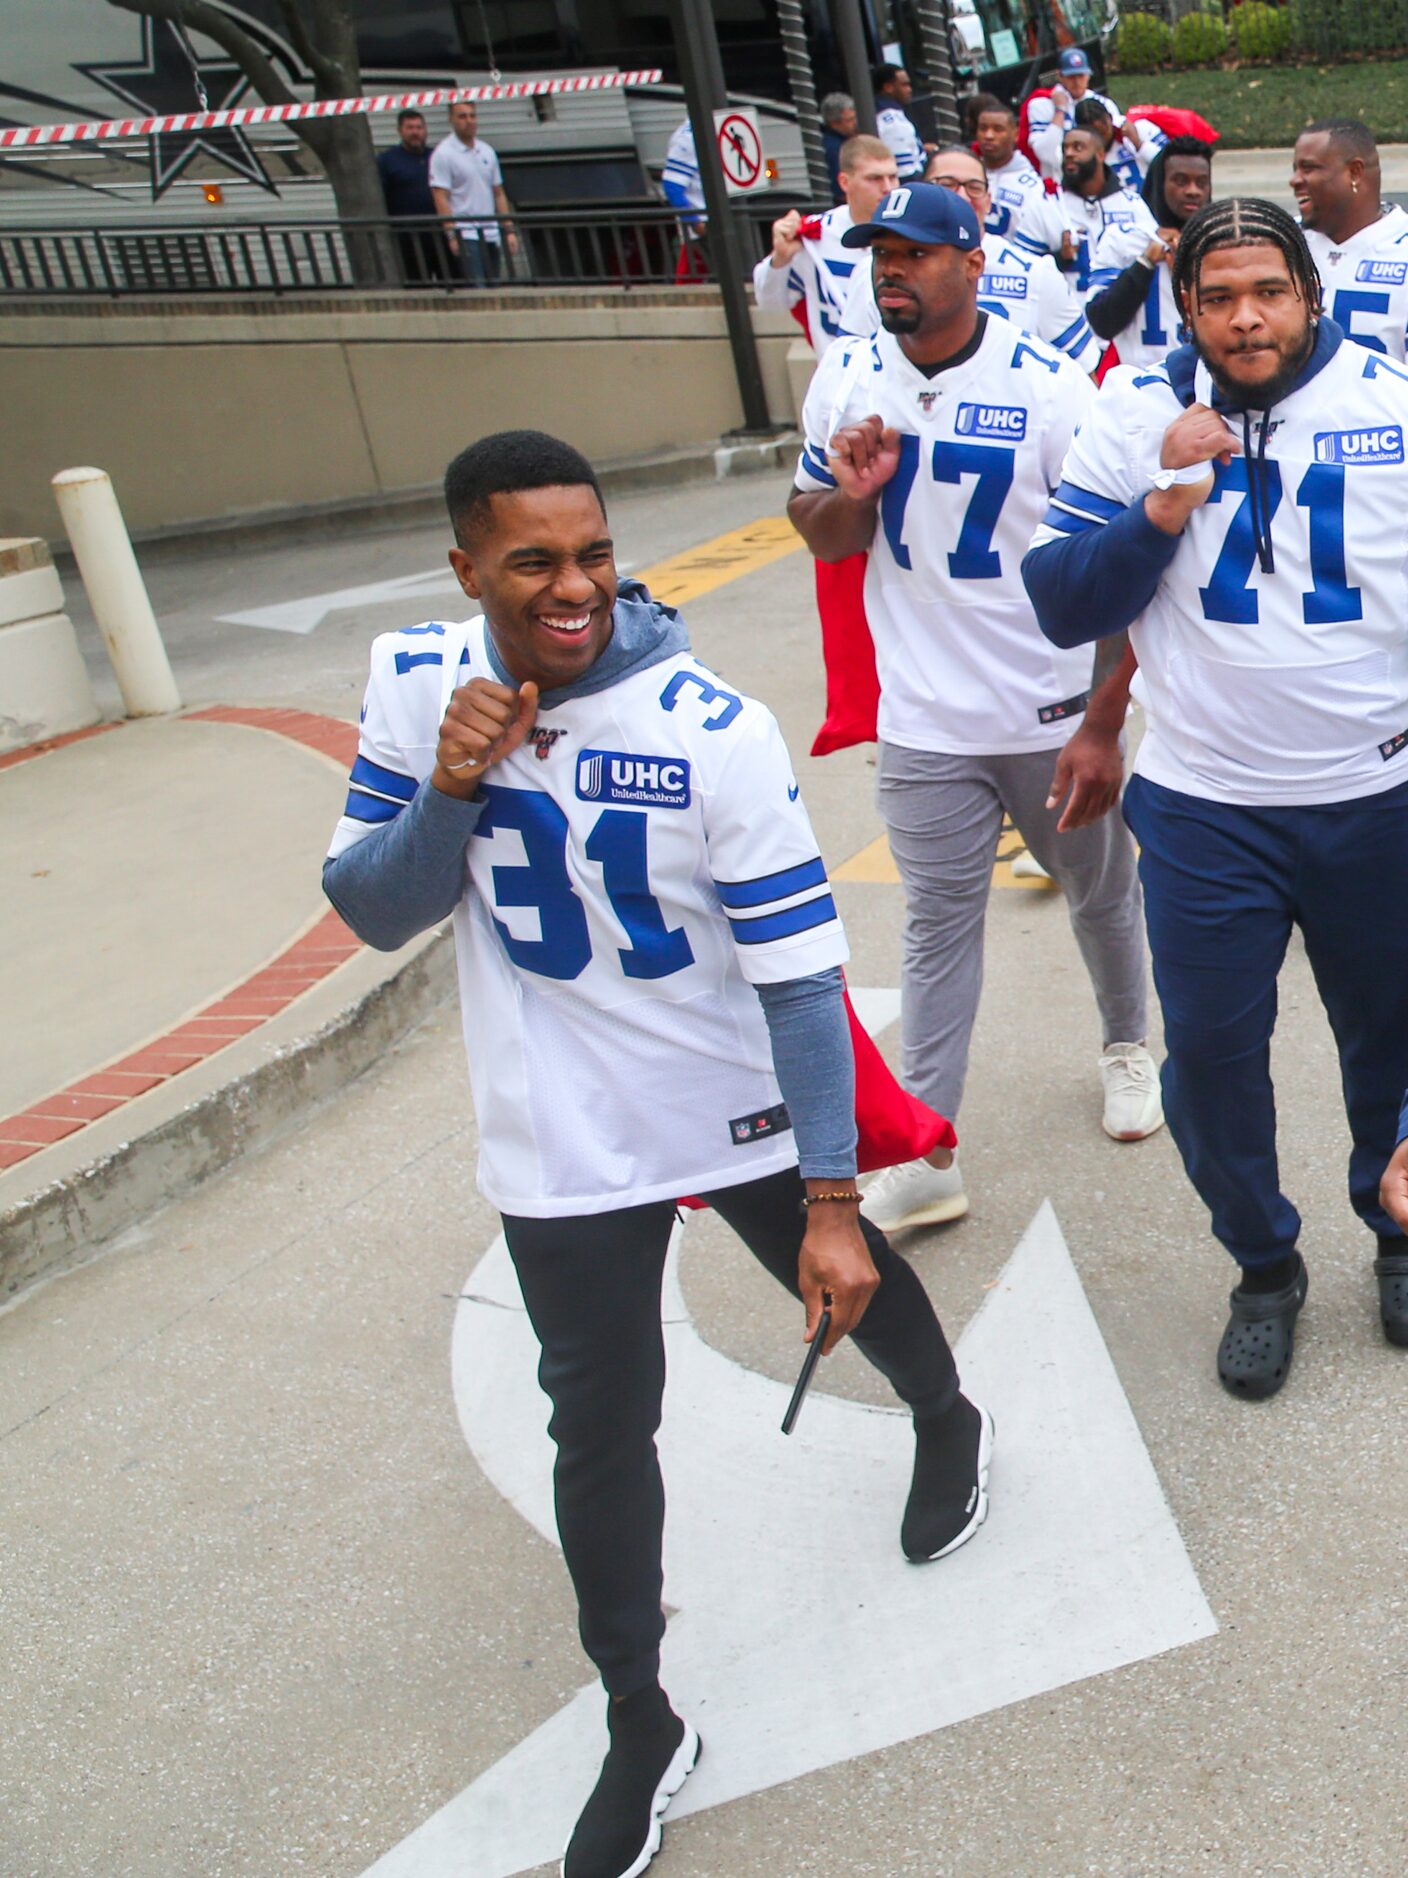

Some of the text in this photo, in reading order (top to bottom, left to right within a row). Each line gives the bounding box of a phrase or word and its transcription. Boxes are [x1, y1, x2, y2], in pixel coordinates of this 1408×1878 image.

[882, 188, 912, 219] D
[991, 276, 1026, 292] UHC
[1371, 263, 1406, 278] UHC
[978, 407, 1025, 430] UHC
[1340, 429, 1400, 455] UHC
[1198, 457, 1364, 626] 71
[611, 759, 685, 791] UHC
[472, 783, 696, 980] 31
